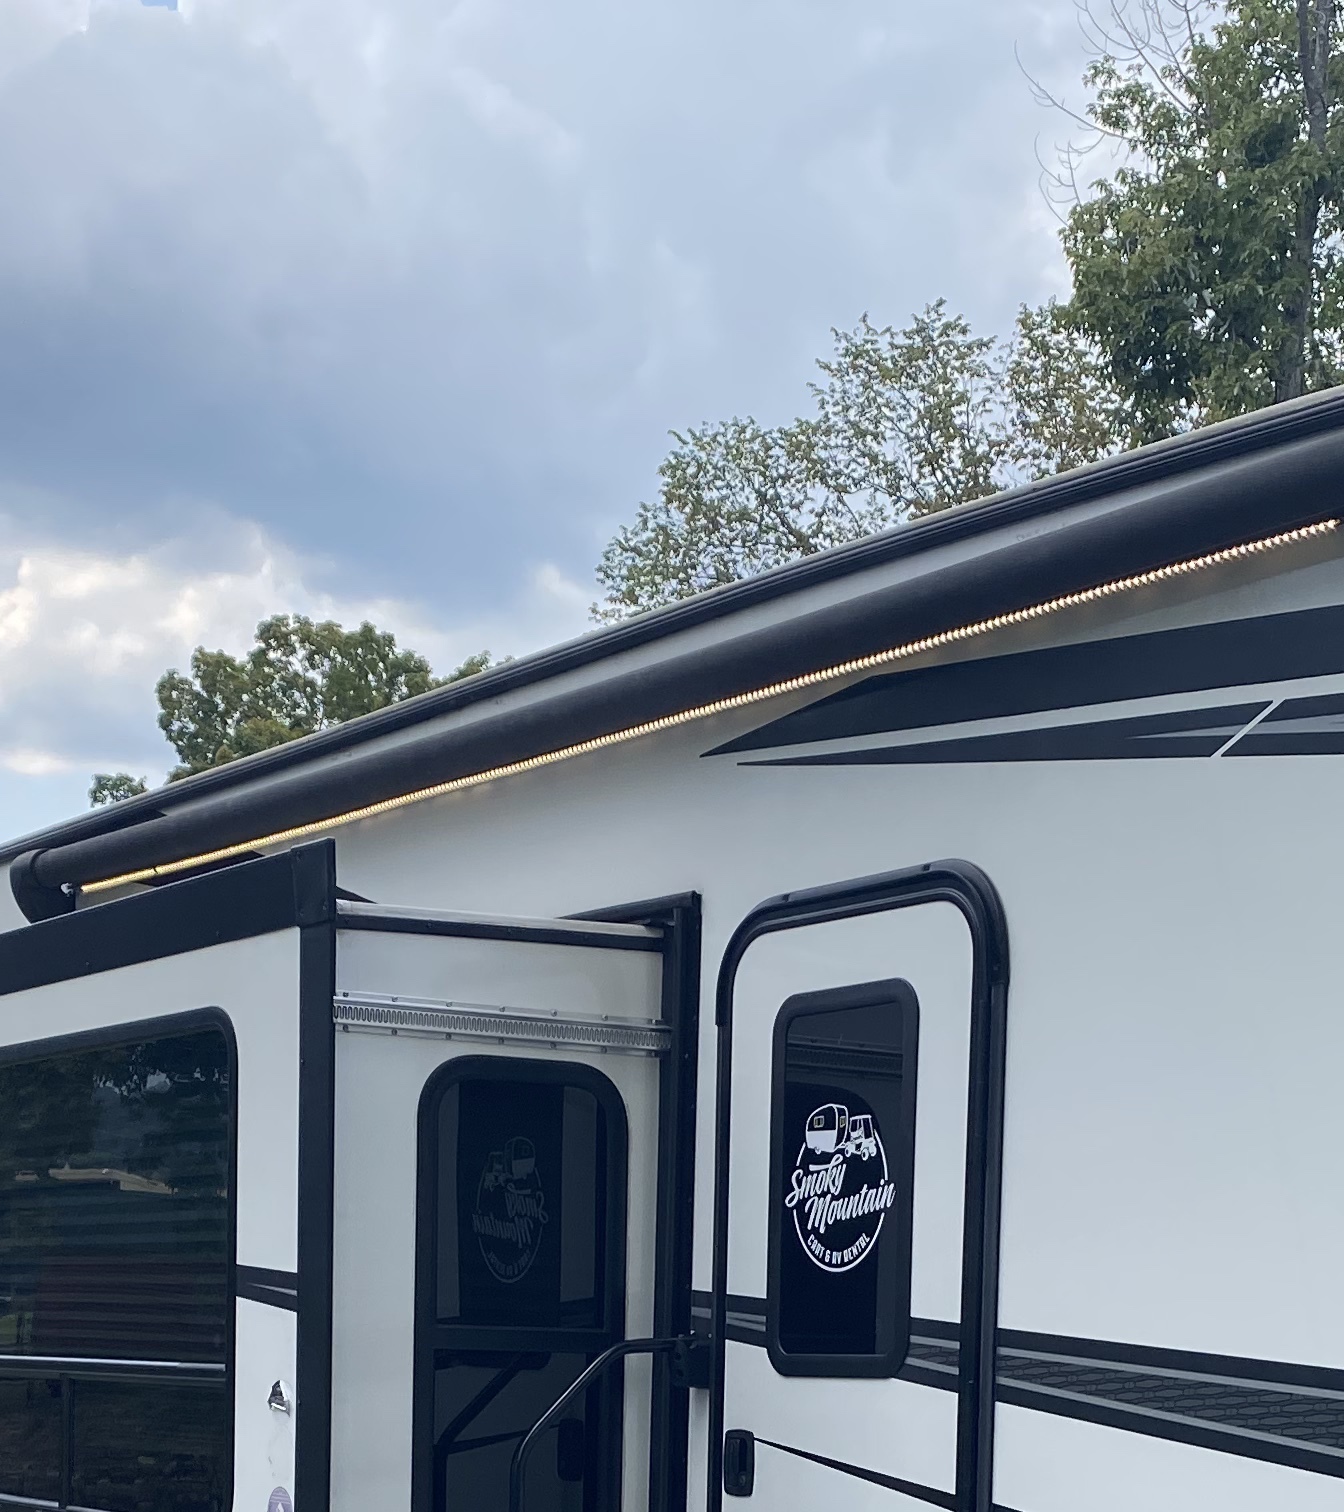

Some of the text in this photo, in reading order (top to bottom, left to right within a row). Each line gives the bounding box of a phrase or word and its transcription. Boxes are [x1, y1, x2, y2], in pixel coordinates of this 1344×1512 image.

[785, 1154, 846, 1207] Smoky
[805, 1179, 896, 1233] Mountain
[807, 1233, 870, 1264] CART & RV RENTAL
